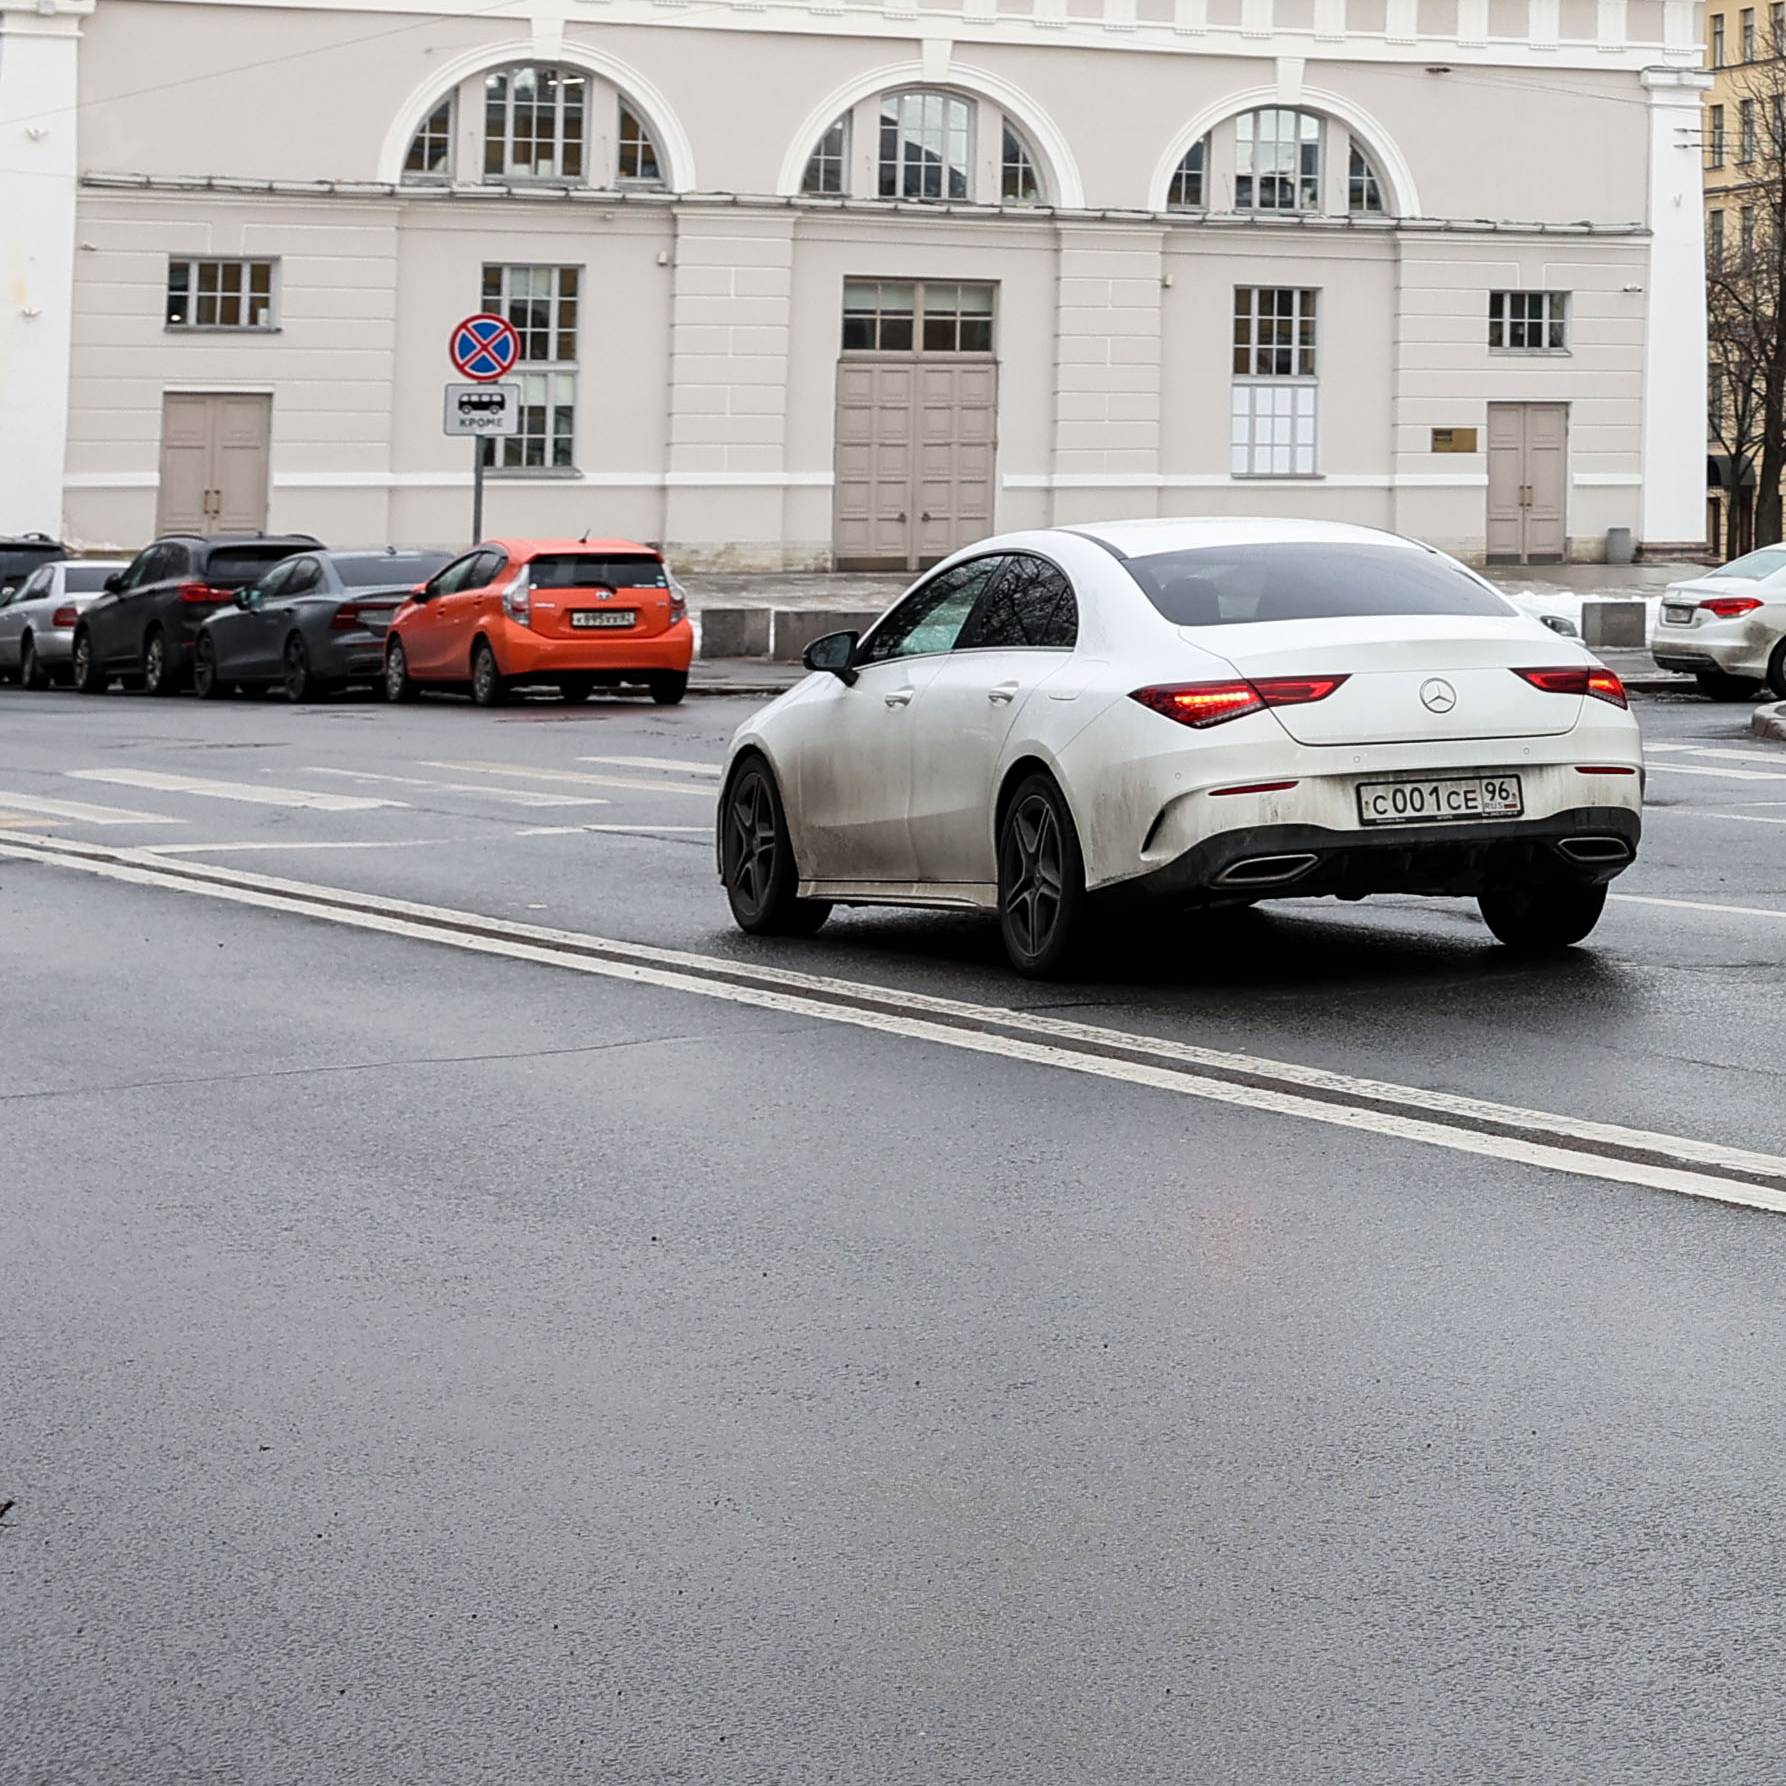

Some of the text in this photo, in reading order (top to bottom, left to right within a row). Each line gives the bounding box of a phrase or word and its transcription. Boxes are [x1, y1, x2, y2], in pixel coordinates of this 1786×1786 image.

[459, 417, 504, 428] КРОМЕ
[1372, 781, 1510, 815] С001СЕ 96
